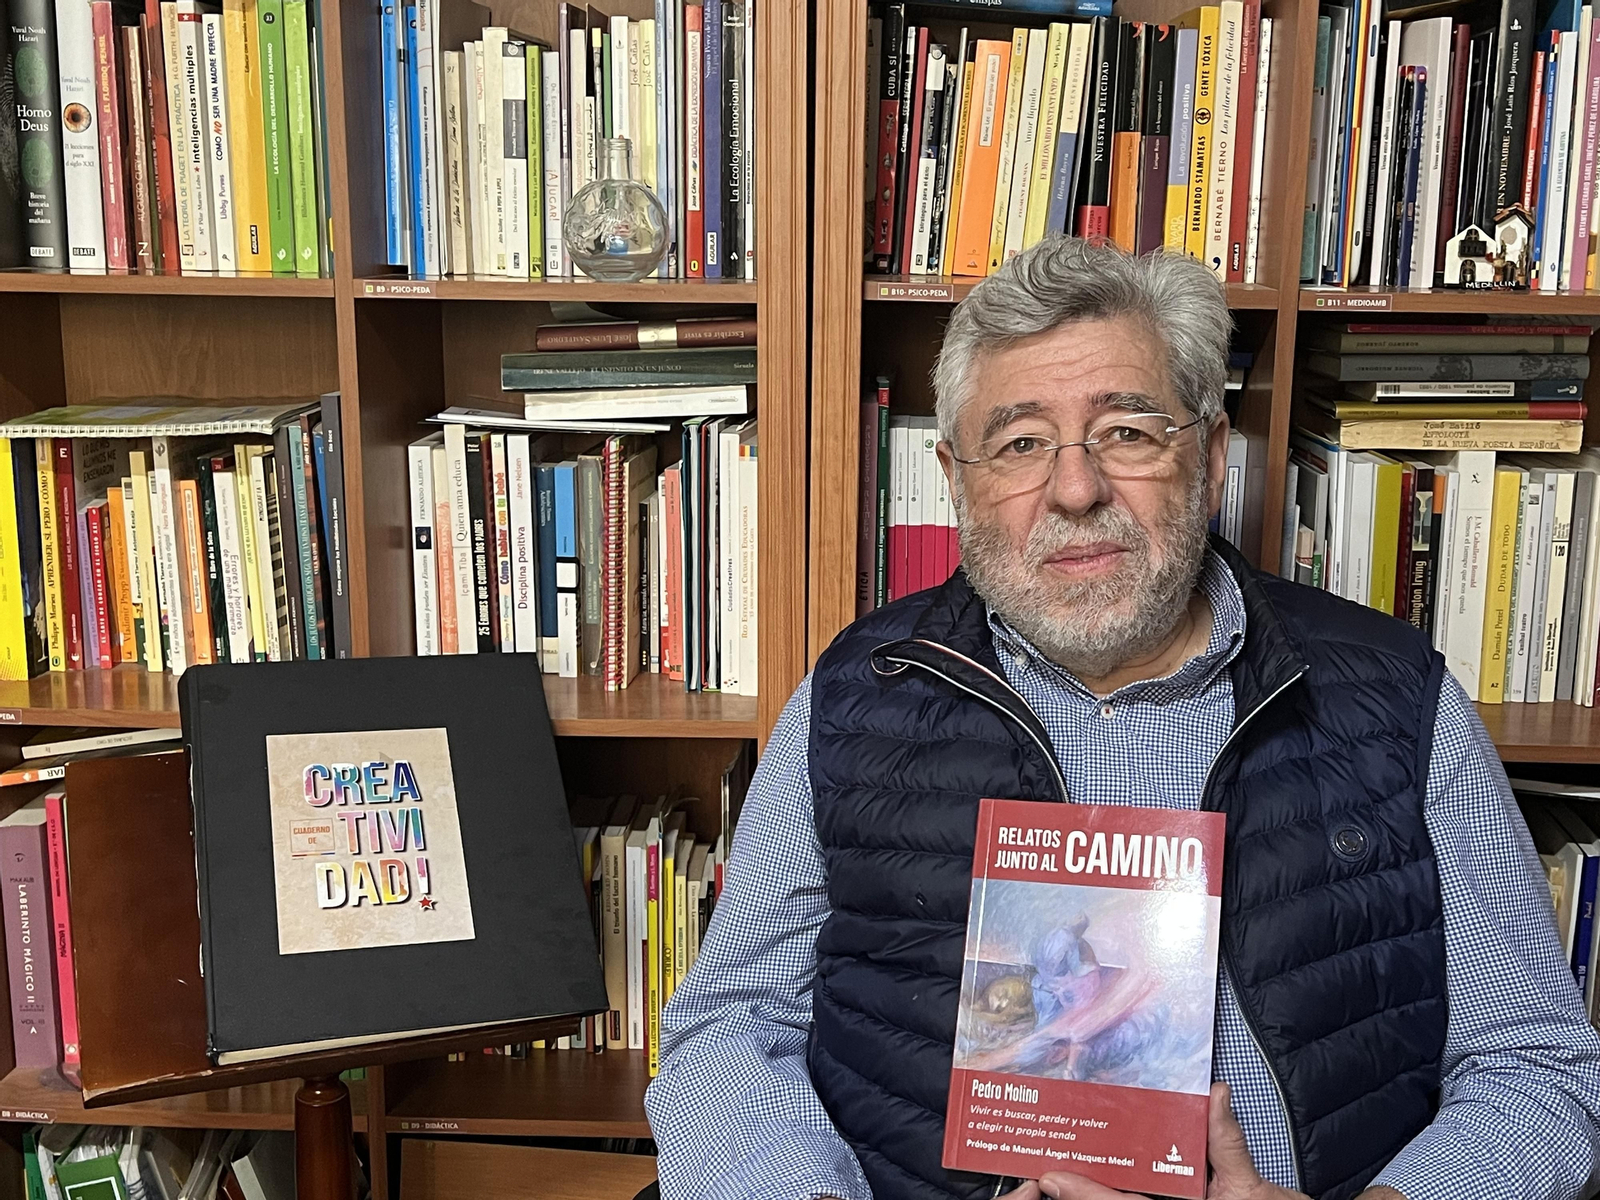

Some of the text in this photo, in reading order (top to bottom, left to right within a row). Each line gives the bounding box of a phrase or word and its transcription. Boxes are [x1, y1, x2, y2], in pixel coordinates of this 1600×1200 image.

[207, 23, 215, 55] PERFECTA
[99, 35, 110, 113] EL FLORIDO PENSIL
[210, 58, 218, 83] MADRE
[630, 40, 640, 87] José Cañas
[643, 40, 653, 87] José Cañas
[888, 55, 896, 96] CUBA SÍ
[17, 105, 51, 118] Homo
[185, 45, 201, 163] Inteligencias múltiples
[211, 86, 219, 103] UNA
[212, 105, 220, 119] SER
[268, 74, 277, 116] DESARROLLO
[1094, 61, 1109, 162] NUESTRA FELICIDAD
[21, 119, 49, 131] Deus
[213, 121, 222, 135] NO
[729, 79, 743, 202] La Ecología Emocional
[1177, 84, 1190, 176] La revolución positiva
[1192, 35, 1212, 231] BERNARDO STAMATEAS GENTE TÓXICA
[1214, 20, 1235, 241] BERNABÉ TIERNO Los pilares de la felicidad
[1497, 42, 1519, 205] EN NOVIEMBRE José Luis Ríos Jorquera
[173, 84, 190, 240] LA TEORÍA DE PIAGET EN LA PRÁCTICA
[215, 136, 223, 160] COMO
[271, 131, 279, 164] ECOLOGÍA
[134, 159, 143, 179] CURY
[273, 166, 279, 174] LA
[136, 183, 145, 222] AUGUSTO
[220, 200, 229, 219] Libby
[1327, 299, 1386, 307] B11 MEDIOAMB
[452, 459, 470, 597] Içami Tiba Quien ama educa
[494, 473, 510, 585] Cómo hablar con tu bebé
[513, 458, 529, 609] Disciplina positiva Jane Nelsen
[231, 555, 243, 629] Errores horrores
[474, 519, 490, 635] 25 ERRORES que cometen los PADRES
[741, 585, 748, 594] DE
[1410, 561, 1426, 628] shington Irving
[1492, 524, 1511, 660] Damián Pretel DUDAR DE TODO
[120, 580, 132, 642] Vladimir Propp
[303, 760, 421, 807] CREA
[294, 826, 330, 834] CUADERNO
[308, 837, 317, 845] DE
[337, 807, 424, 854] TIVI
[998, 827, 1061, 848] RELATOS
[994, 850, 1058, 872] JUNTO AL
[1065, 830, 1205, 879] CAMINO
[315, 857, 436, 909] DAD!
[18, 884, 32, 944] LABERINTO
[22, 948, 35, 991] MÁGICO
[972, 1079, 1039, 1104] Pedro Molino
[16, 1111, 48, 1119] DIDÁCTICA
[970, 1105, 1108, 1129] Vivir es buscar, perder y volver
[976, 1121, 1003, 1133] elegir
[1005, 1125, 1014, 1133] tu
[1016, 1127, 1046, 1139] propia
[1048, 1129, 1076, 1141] senda
[966, 1139, 1135, 1167] Prólogo de Manuel Ángel Vázquez Medel
[1152, 1160, 1194, 1176] Liberman
